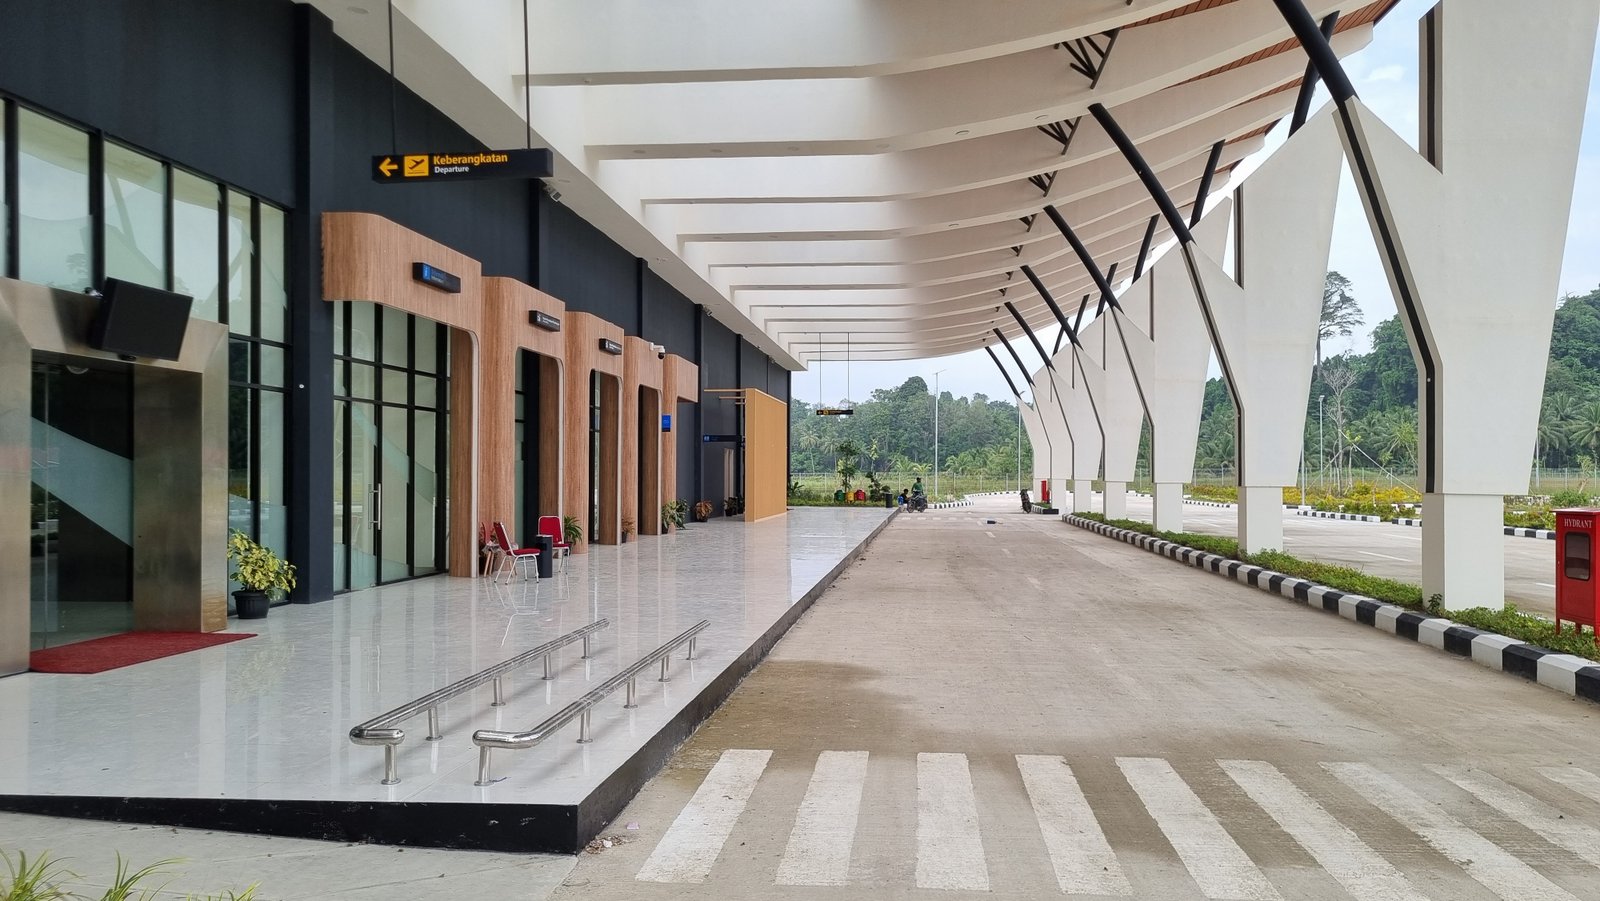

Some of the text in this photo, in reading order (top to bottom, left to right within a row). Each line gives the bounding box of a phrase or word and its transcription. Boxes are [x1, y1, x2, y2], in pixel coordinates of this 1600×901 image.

[433, 152, 508, 166] Keberangkatan
[434, 166, 470, 175] Departure
[1564, 518, 1592, 529] HYDRANT
